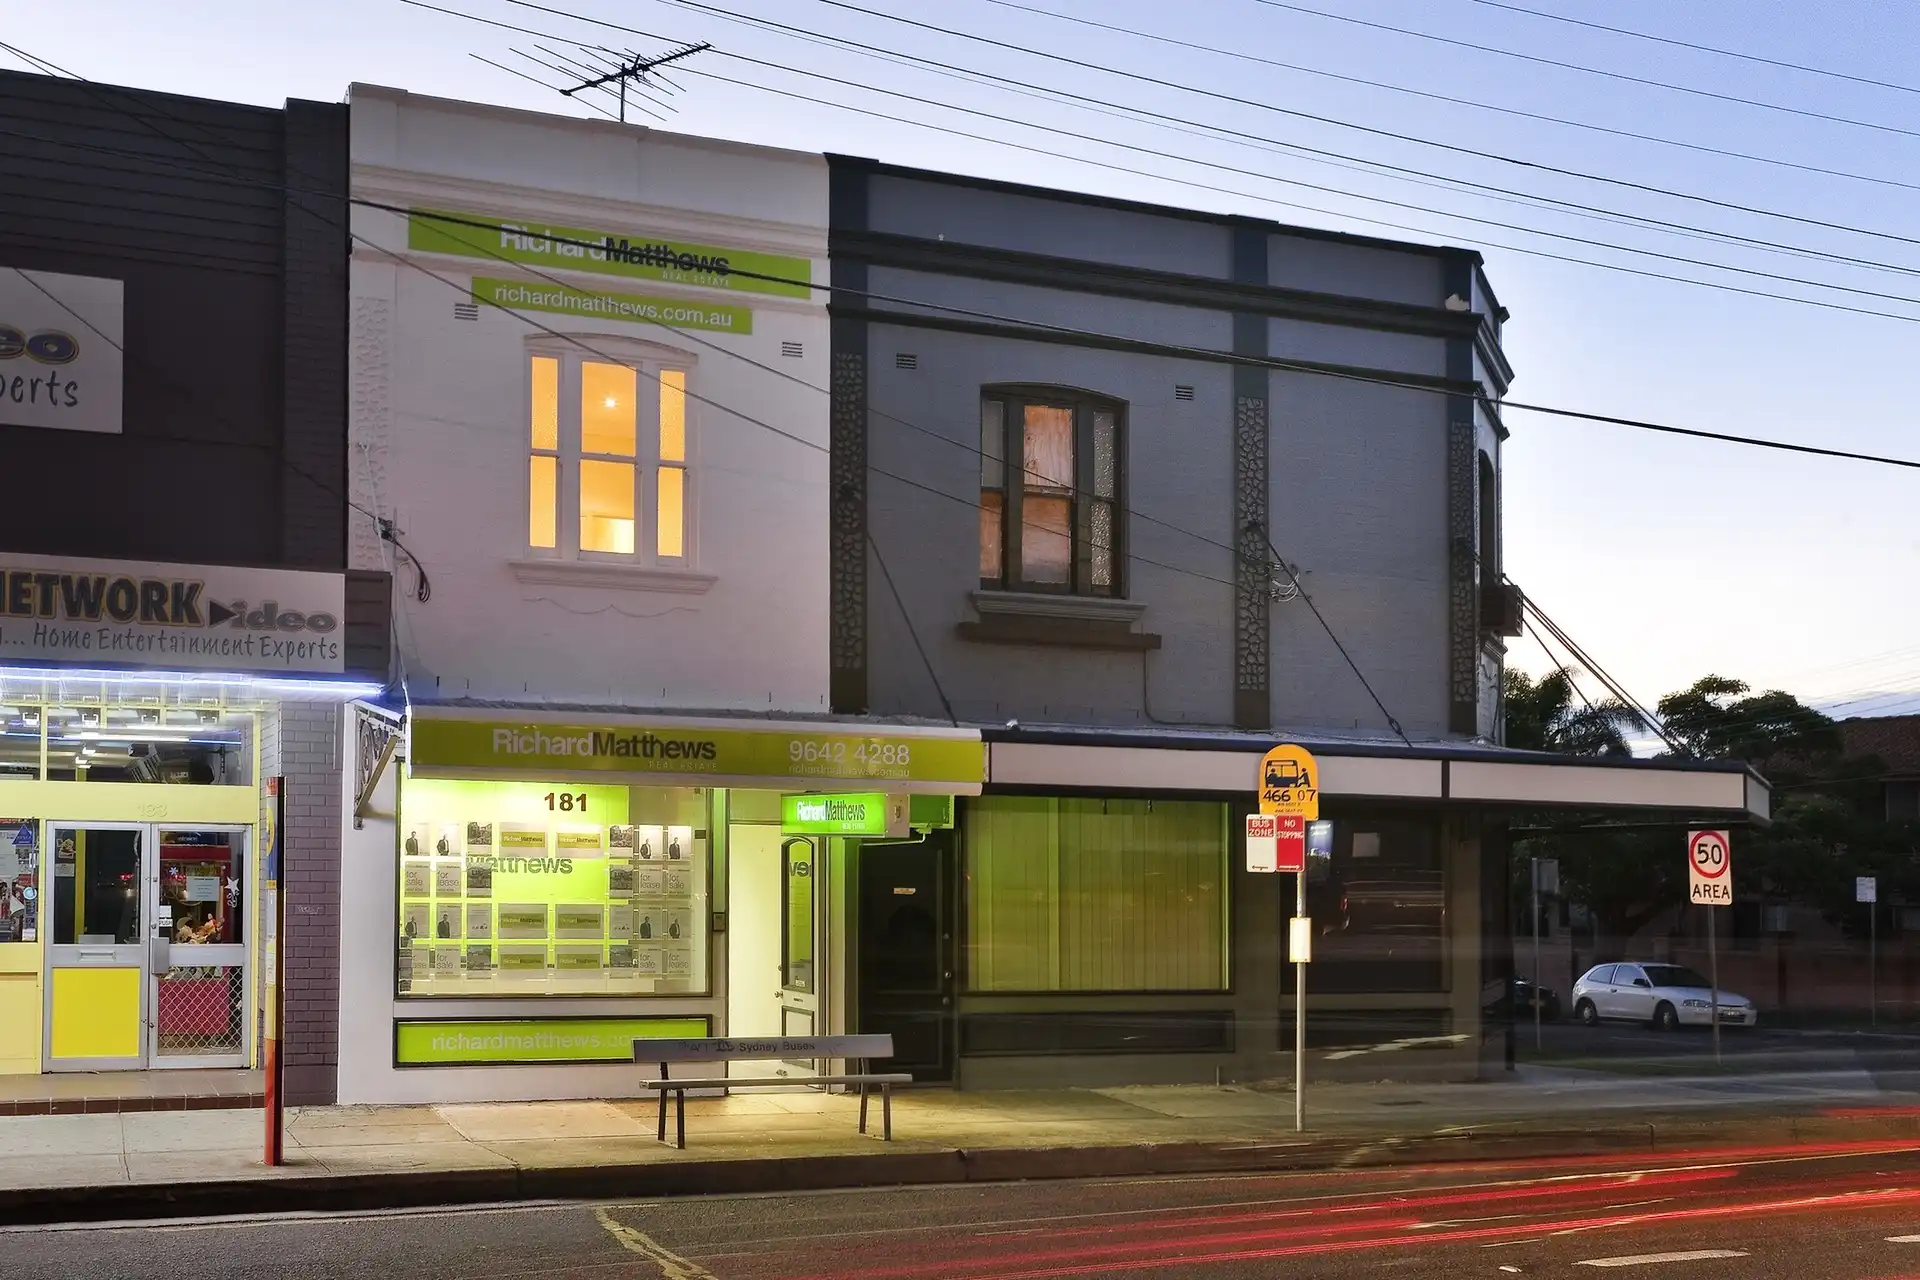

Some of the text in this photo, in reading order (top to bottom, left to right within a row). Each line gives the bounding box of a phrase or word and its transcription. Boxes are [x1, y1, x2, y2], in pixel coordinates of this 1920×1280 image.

[494, 285, 733, 327] richardmatthews.com.au
[0, 570, 205, 627] ETWORK
[33, 622, 92, 650] Home
[97, 627, 255, 659] Entertainment
[259, 635, 338, 665] Experts
[789, 740, 911, 766] 9642 4288
[544, 792, 587, 812] 181
[1263, 789, 1317, 802] 466 07
[1252, 820, 1270, 828] BUS
[1284, 819, 1296, 828] NO
[1249, 828, 1274, 837] ZONE
[1276, 830, 1304, 840] STOPPING
[1697, 843, 1722, 865] 50
[1692, 883, 1731, 900] AREA
[738, 1042, 779, 1053] Sydney
[783, 1040, 816, 1051] Buses
